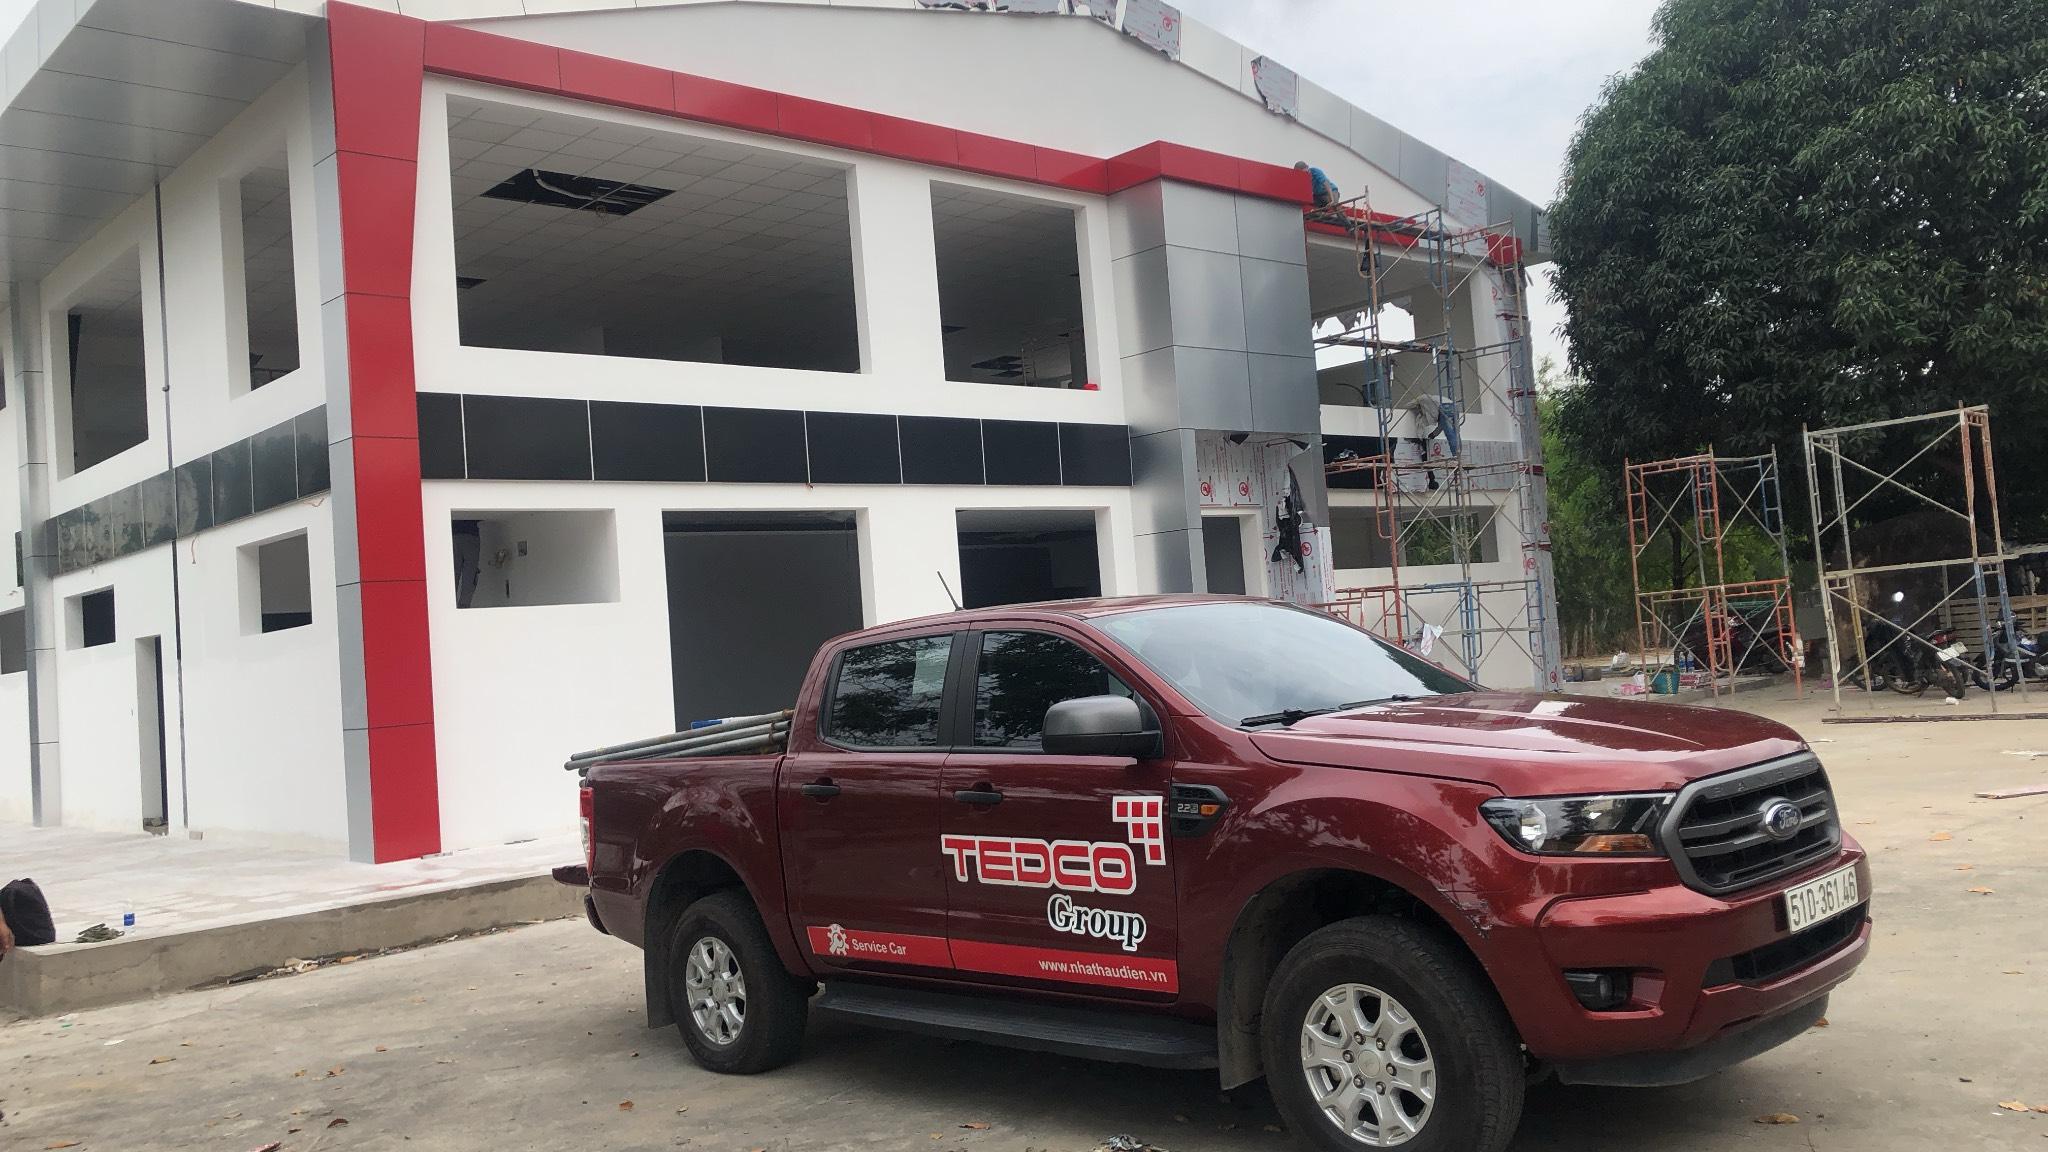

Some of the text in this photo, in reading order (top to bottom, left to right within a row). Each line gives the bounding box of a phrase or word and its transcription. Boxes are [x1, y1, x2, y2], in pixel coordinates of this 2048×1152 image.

[1778, 807, 1801, 830] Ford
[941, 834, 1136, 895] TEDCO
[1047, 893, 1147, 952] Group
[851, 938, 907, 955] Service Car
[1038, 960, 1168, 983] www.nhathaudien.vn
